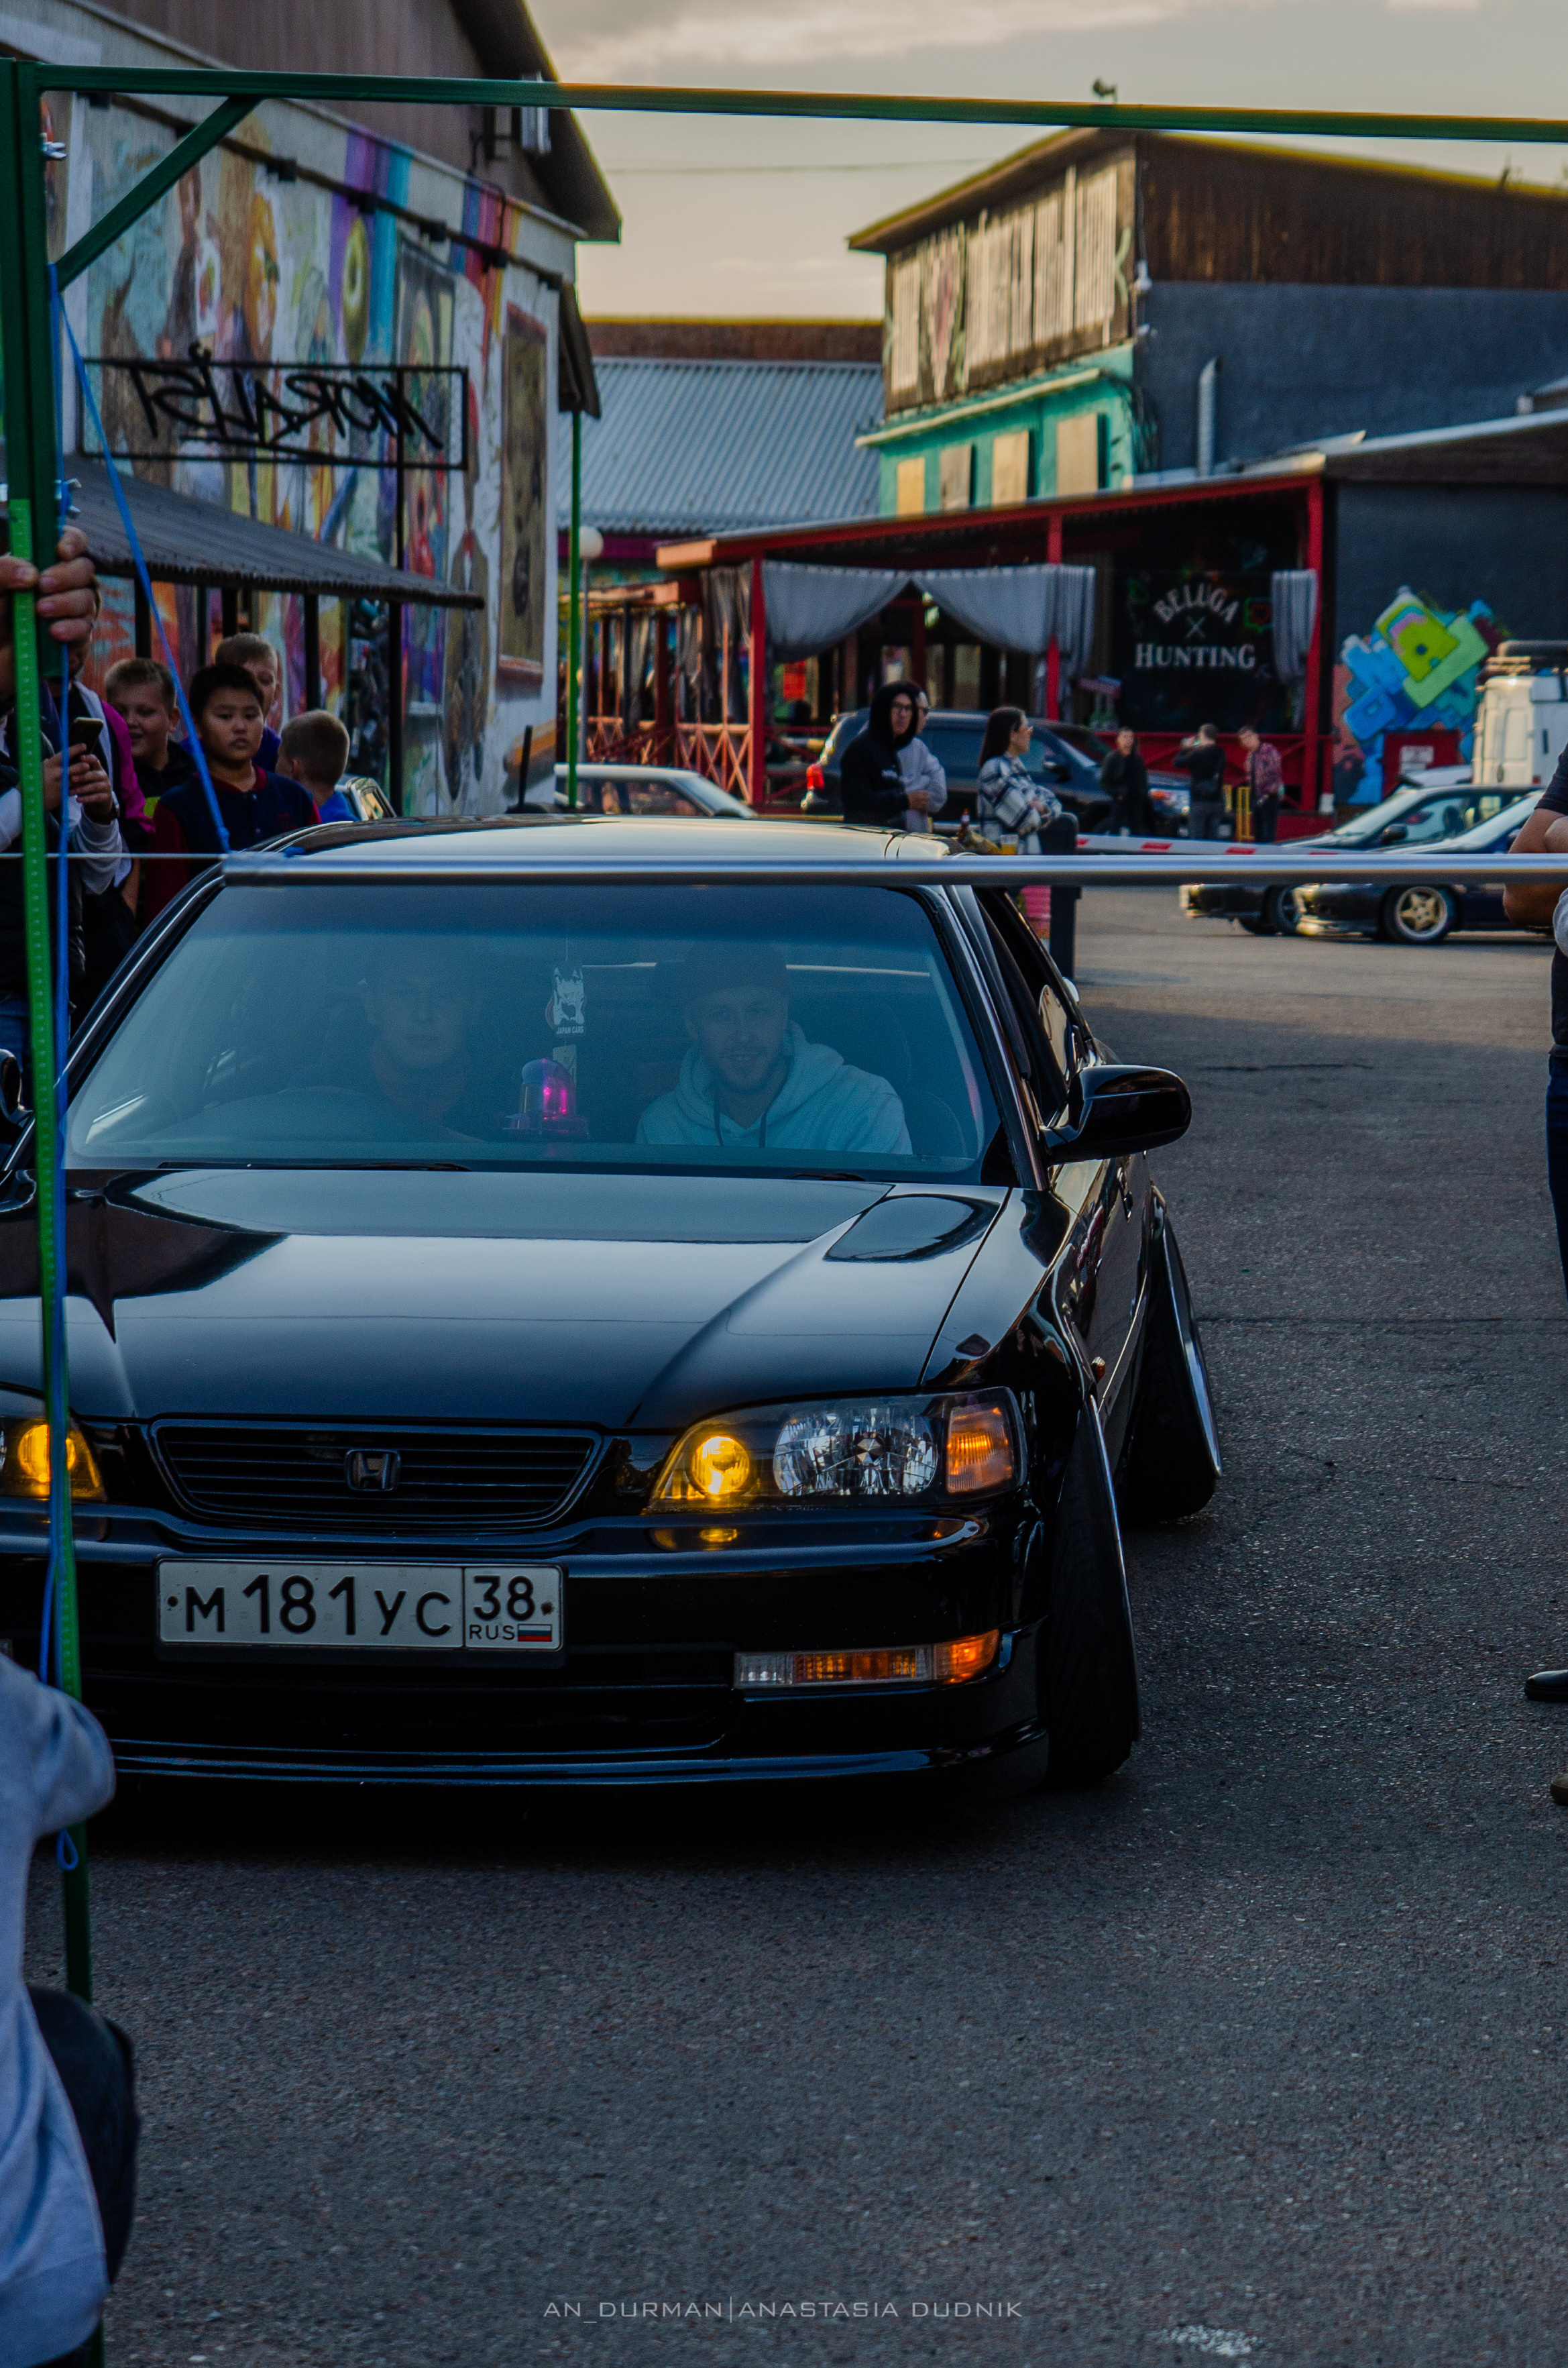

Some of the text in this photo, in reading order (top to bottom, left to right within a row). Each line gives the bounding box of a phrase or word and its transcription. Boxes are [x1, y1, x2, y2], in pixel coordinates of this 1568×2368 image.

[1153, 582, 1239, 625] BELUGA
[1134, 642, 1256, 669] HUNTING
[473, 1575, 536, 1621] 38
[470, 1624, 515, 1641] RUS
